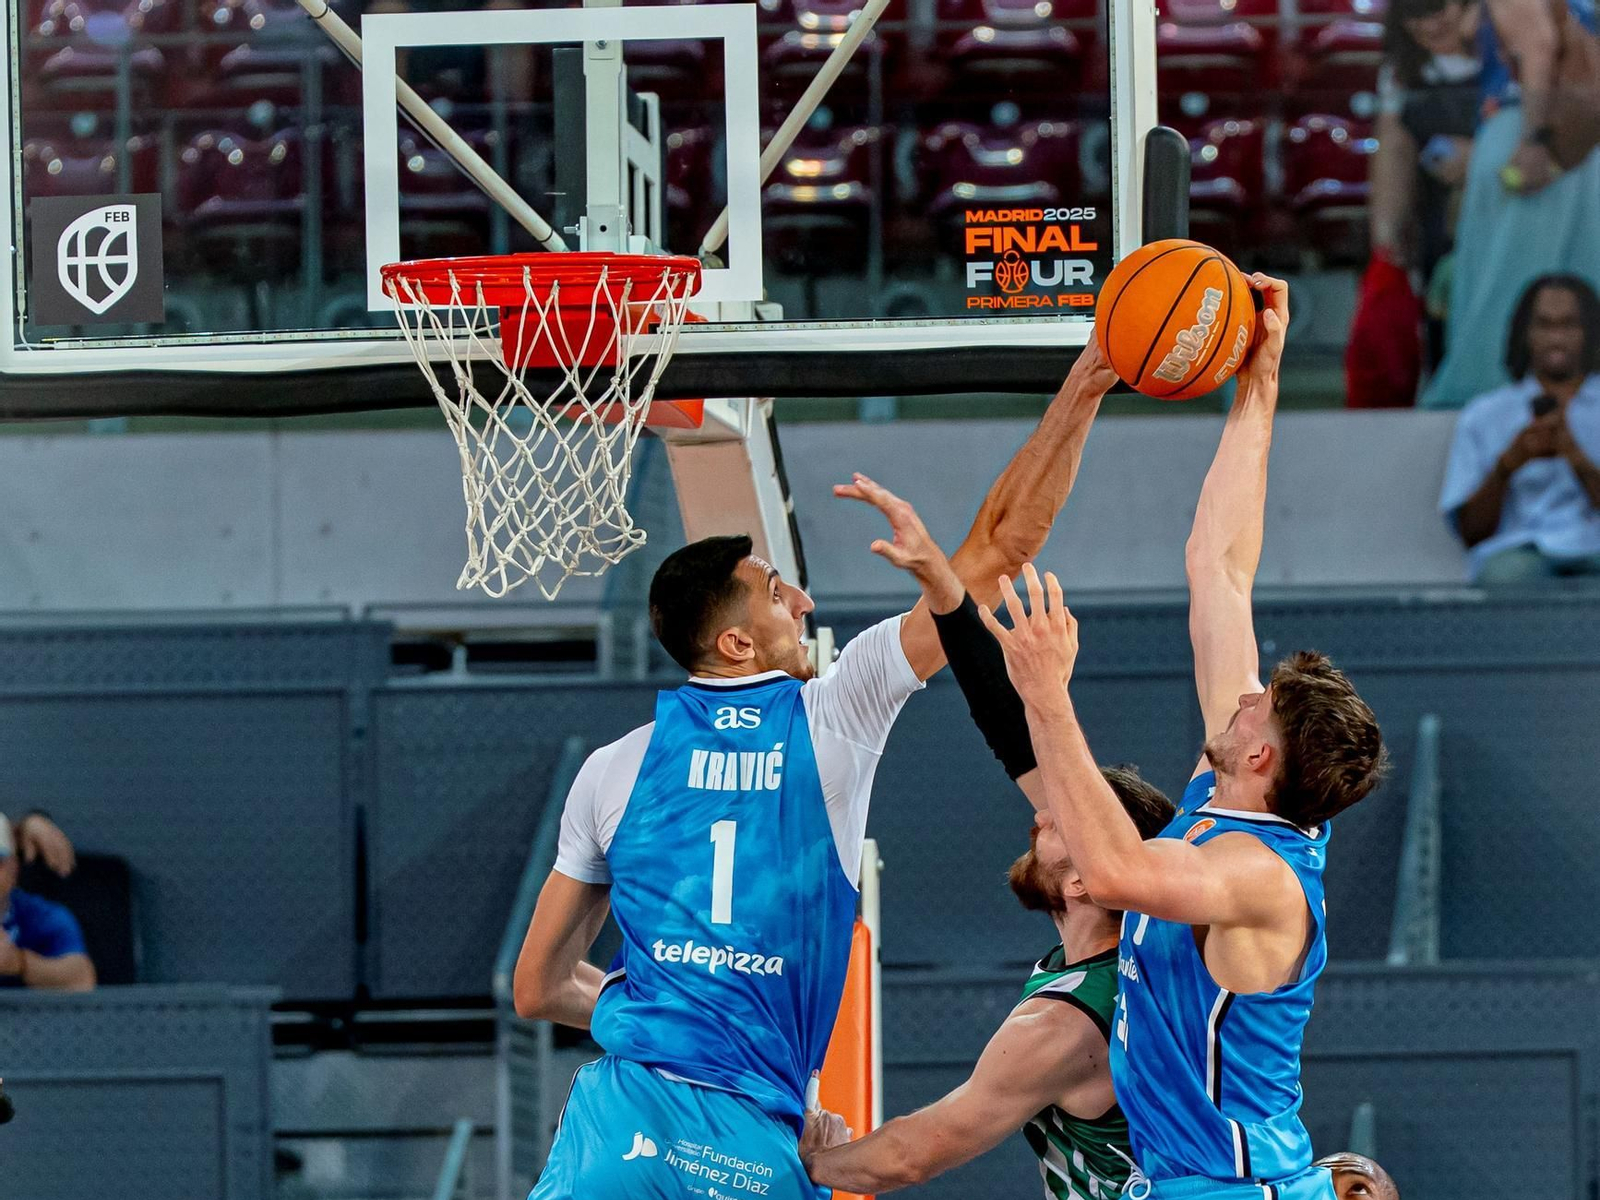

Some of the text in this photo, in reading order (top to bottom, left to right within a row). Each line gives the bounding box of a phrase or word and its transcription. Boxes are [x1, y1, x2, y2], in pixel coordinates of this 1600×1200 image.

[105, 211, 130, 223] FEB
[966, 225, 1098, 254] FINAL
[966, 293, 1095, 309] PRIMERA FEB
[1152, 287, 1224, 383] Wilson
[714, 706, 762, 730] as
[687, 742, 785, 791] KRAVIĆ
[709, 819, 738, 925] 1
[651, 938, 784, 977] telepizza
[663, 1148, 730, 1185] Jiménez
[732, 1172, 770, 1196] Díaz
[701, 1145, 774, 1178] Fundación
